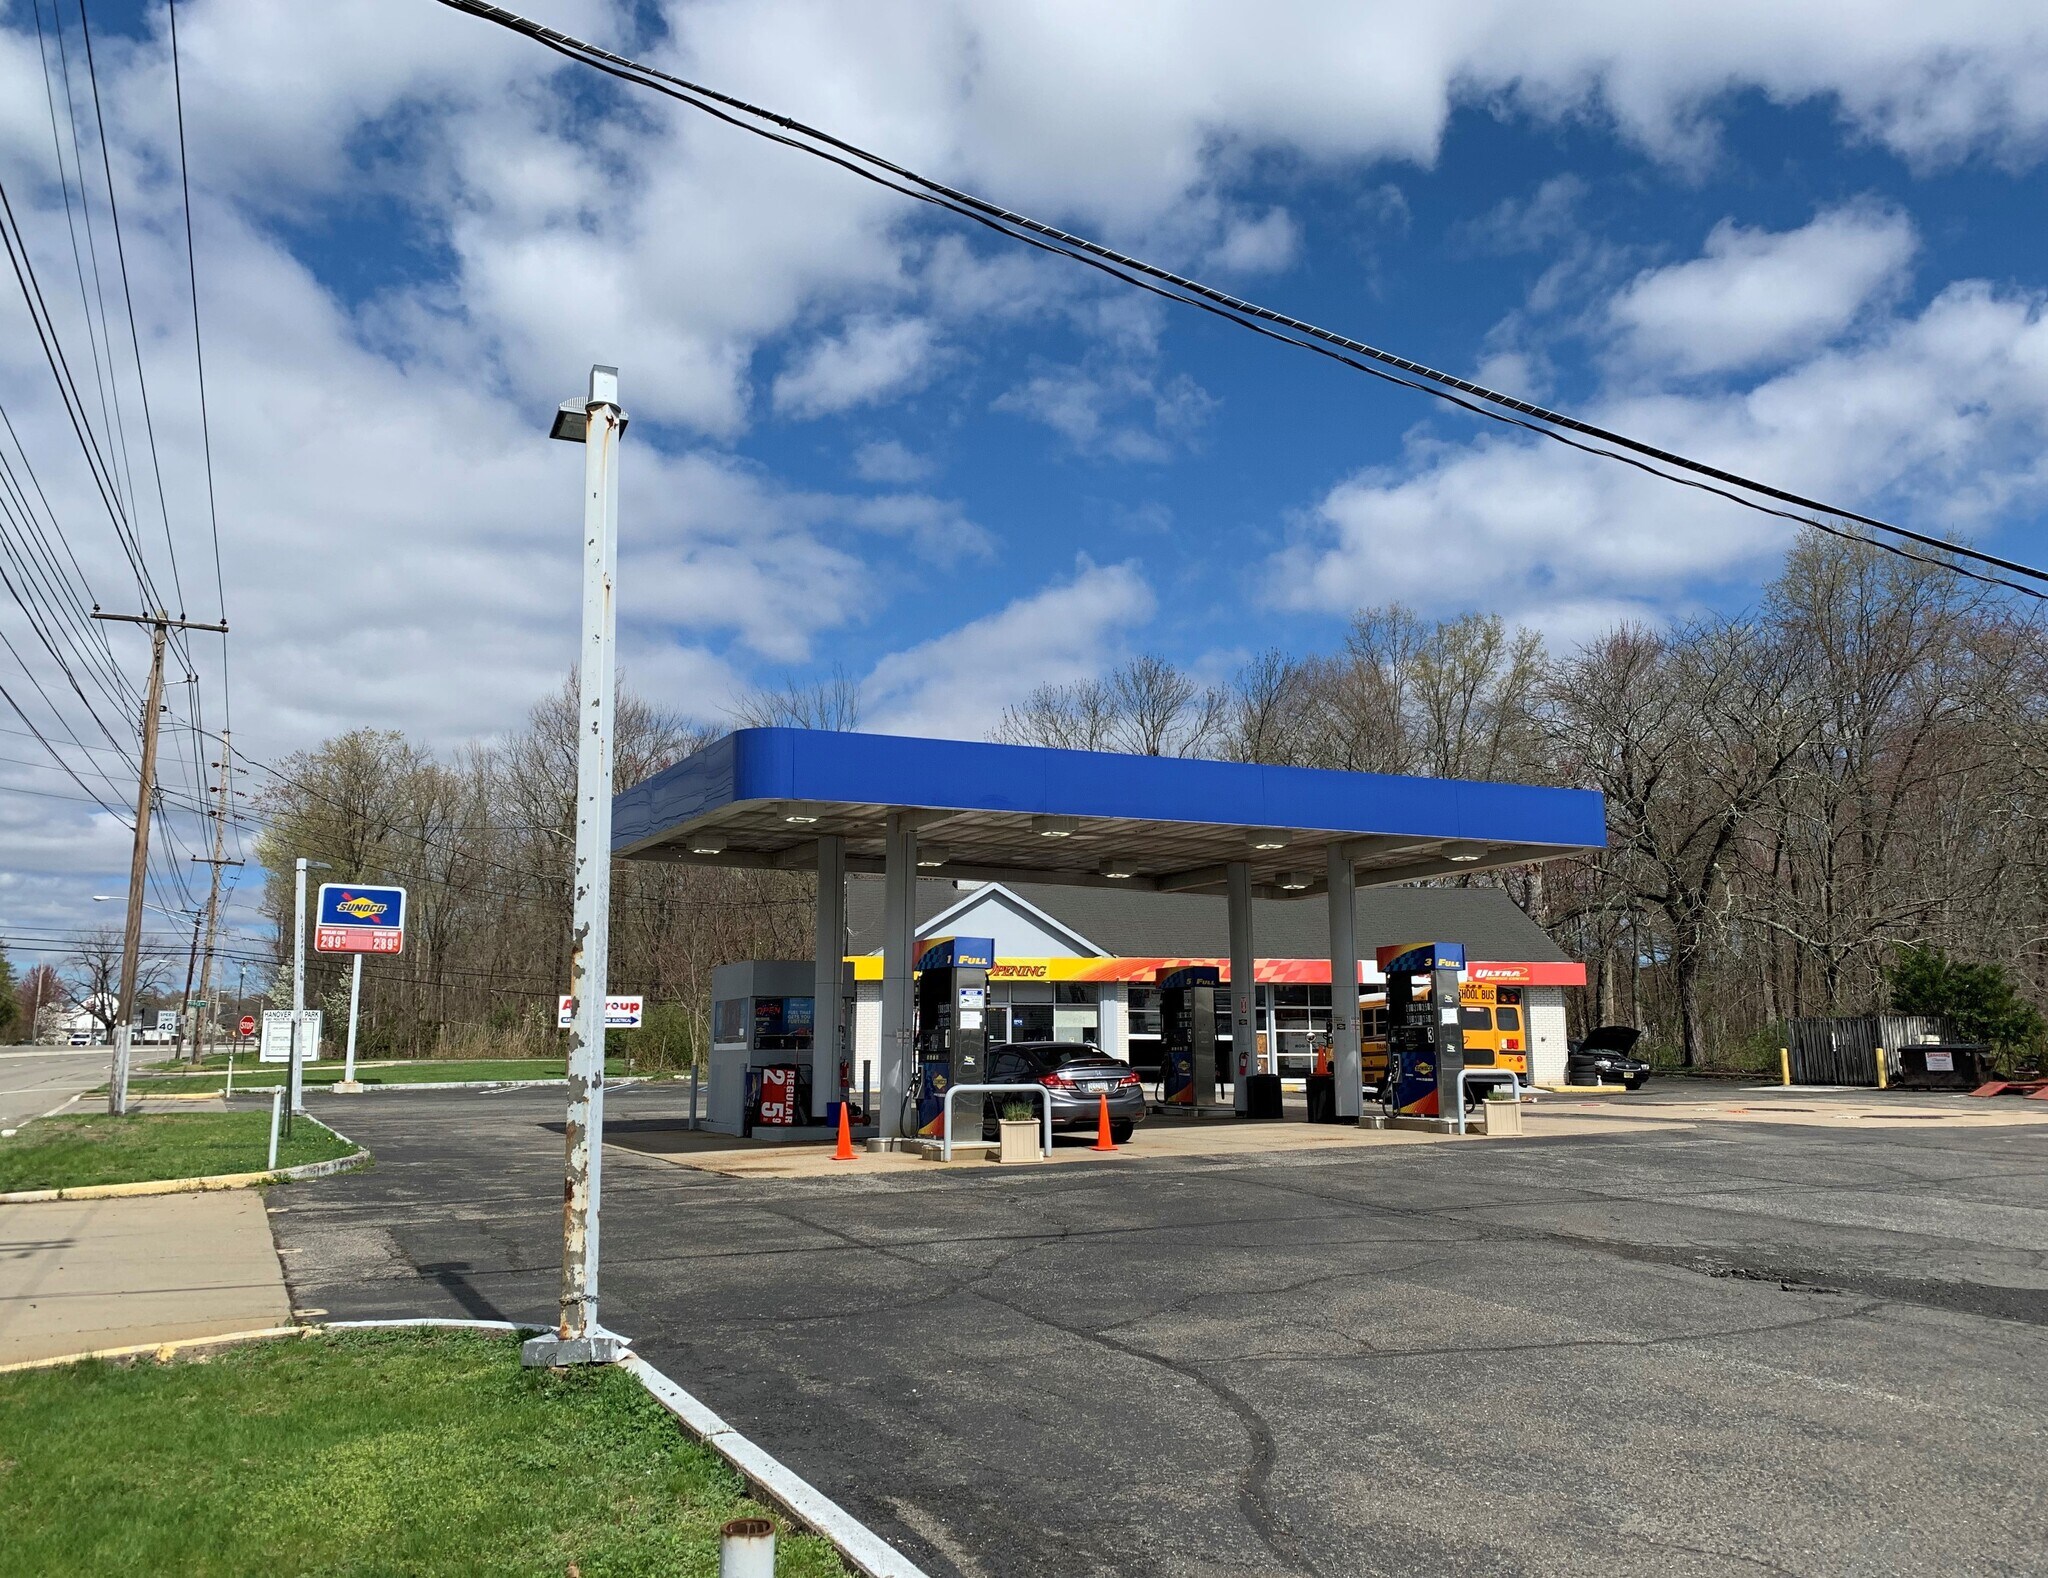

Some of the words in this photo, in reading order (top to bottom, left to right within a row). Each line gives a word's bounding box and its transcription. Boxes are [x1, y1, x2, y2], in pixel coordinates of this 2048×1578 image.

[338, 903, 386, 913] SUNOCO
[946, 955, 952, 964] 1
[1424, 958, 1433, 967] 3
[1475, 969, 1521, 978] ULTRA
[1458, 988, 1478, 1000] CHOOL
[1482, 989, 1494, 1000] BUS
[605, 1002, 640, 1014] roup
[756, 1007, 781, 1015] OPEN
[240, 1021, 254, 1030] STOP
[784, 1070, 796, 1124] REGULAR
